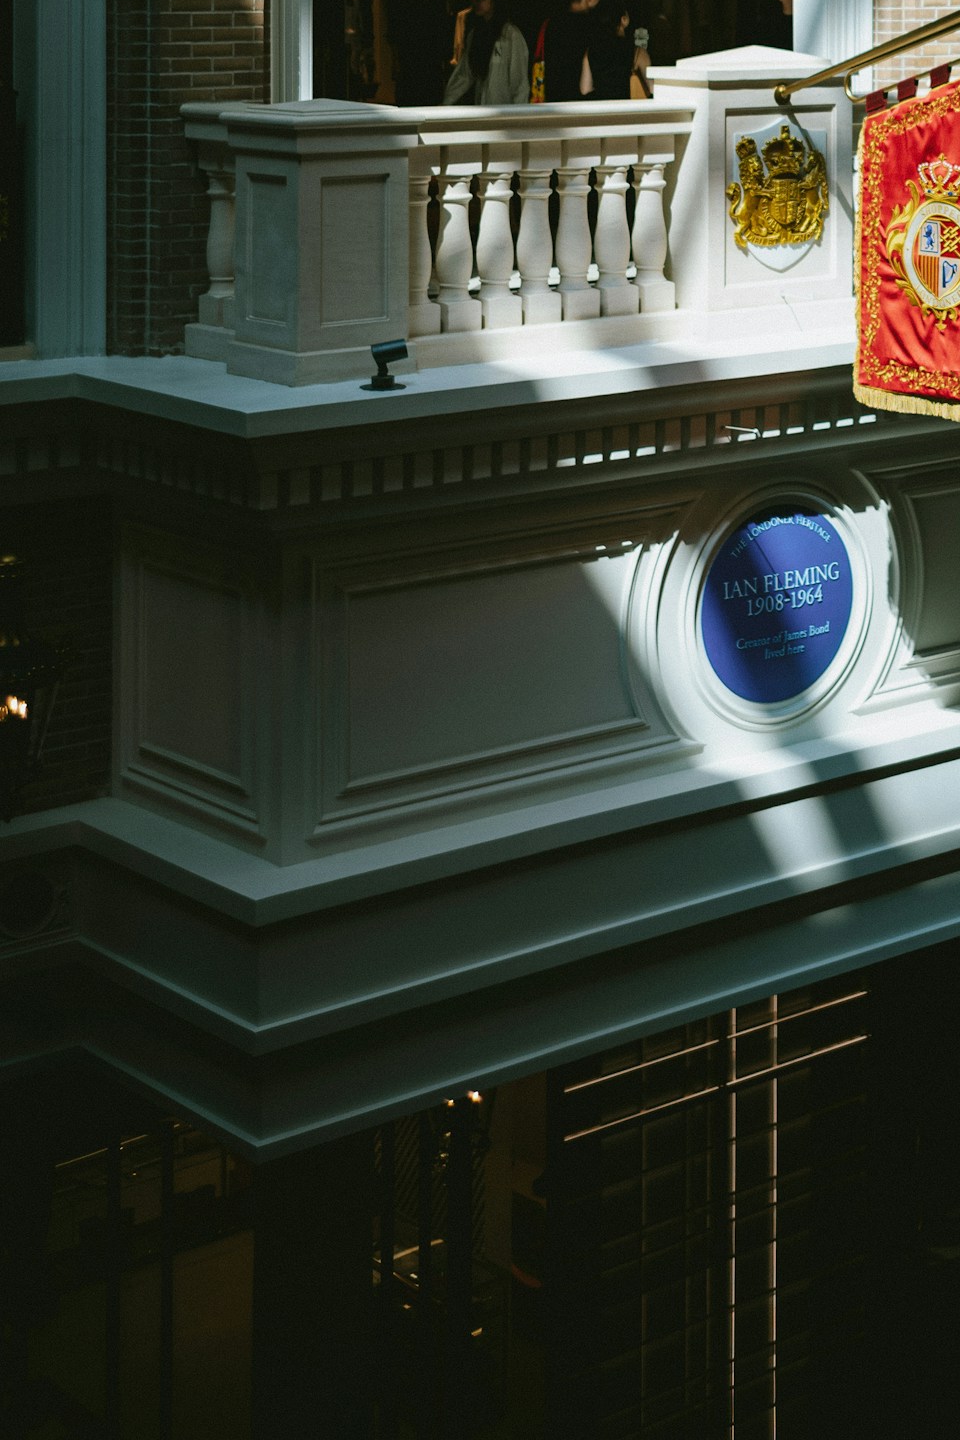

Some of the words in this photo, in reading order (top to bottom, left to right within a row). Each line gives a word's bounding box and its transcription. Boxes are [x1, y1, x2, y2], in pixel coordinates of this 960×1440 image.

[730, 537, 748, 558] THE
[795, 515, 832, 543] HERITAGE
[723, 578, 758, 600] IAN
[763, 562, 840, 593] FLEMING
[747, 584, 823, 616] 1908-1964
[736, 637, 772, 650] Creator
[783, 629, 808, 644] James
[808, 620, 830, 637] Bond
[764, 645, 786, 660] lived
[787, 643, 806, 656] here
